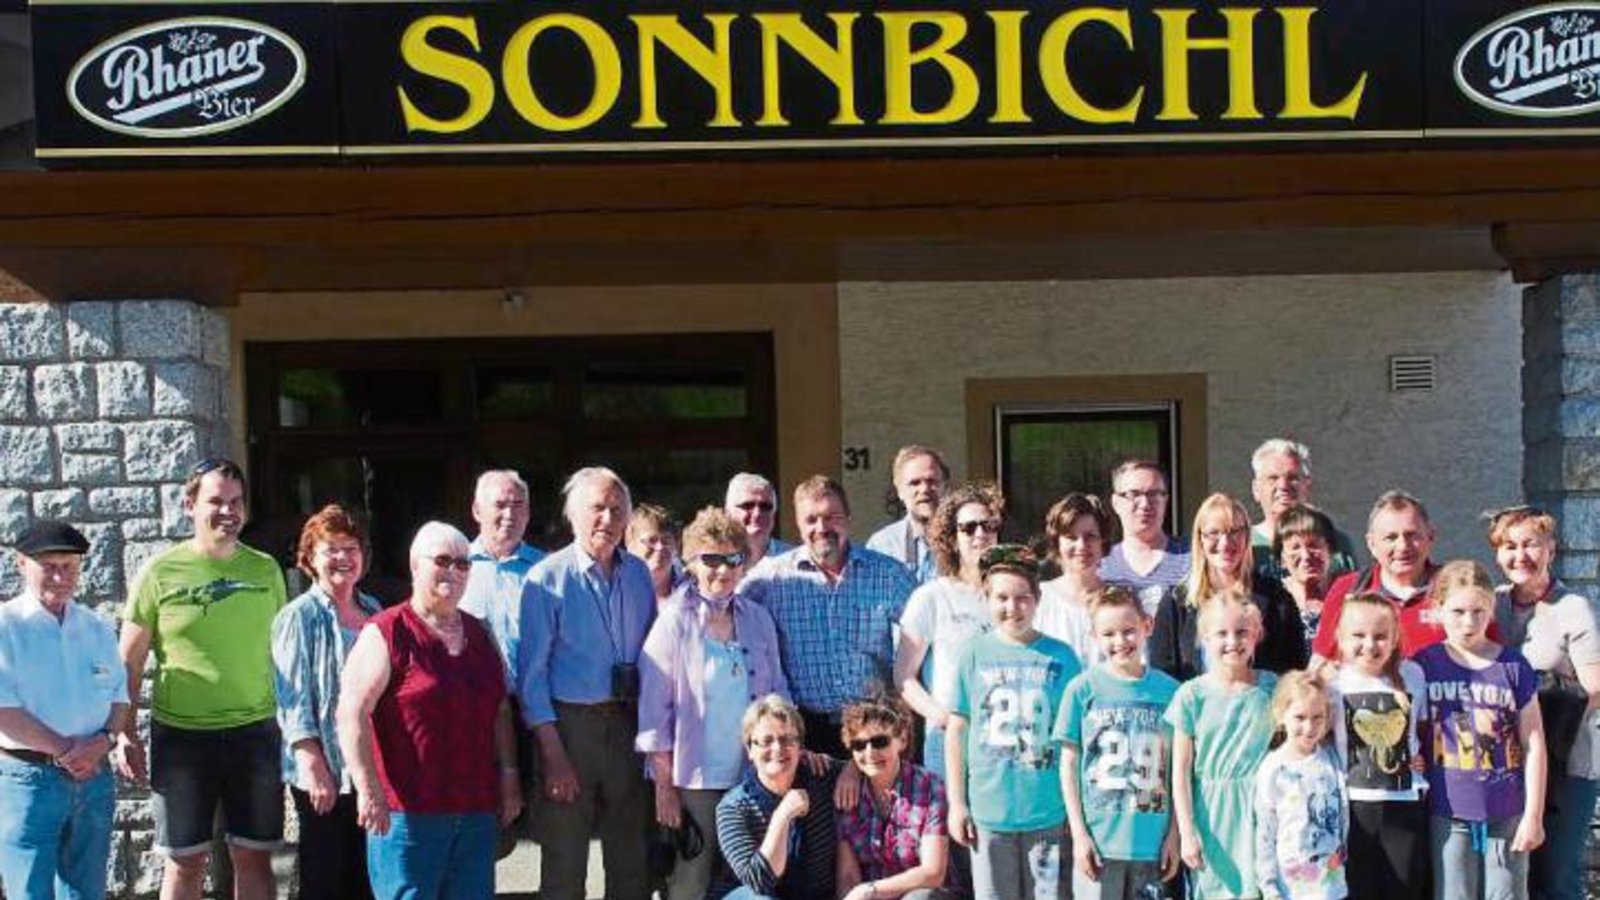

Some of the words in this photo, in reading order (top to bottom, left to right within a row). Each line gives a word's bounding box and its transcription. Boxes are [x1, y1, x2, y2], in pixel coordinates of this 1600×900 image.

[102, 34, 265, 110] Rhaner
[398, 7, 1367, 133] SONNBICHL
[194, 88, 256, 118] Bier
[844, 446, 870, 470] 31
[987, 686, 1050, 746] 29
[1093, 730, 1163, 790] 29
